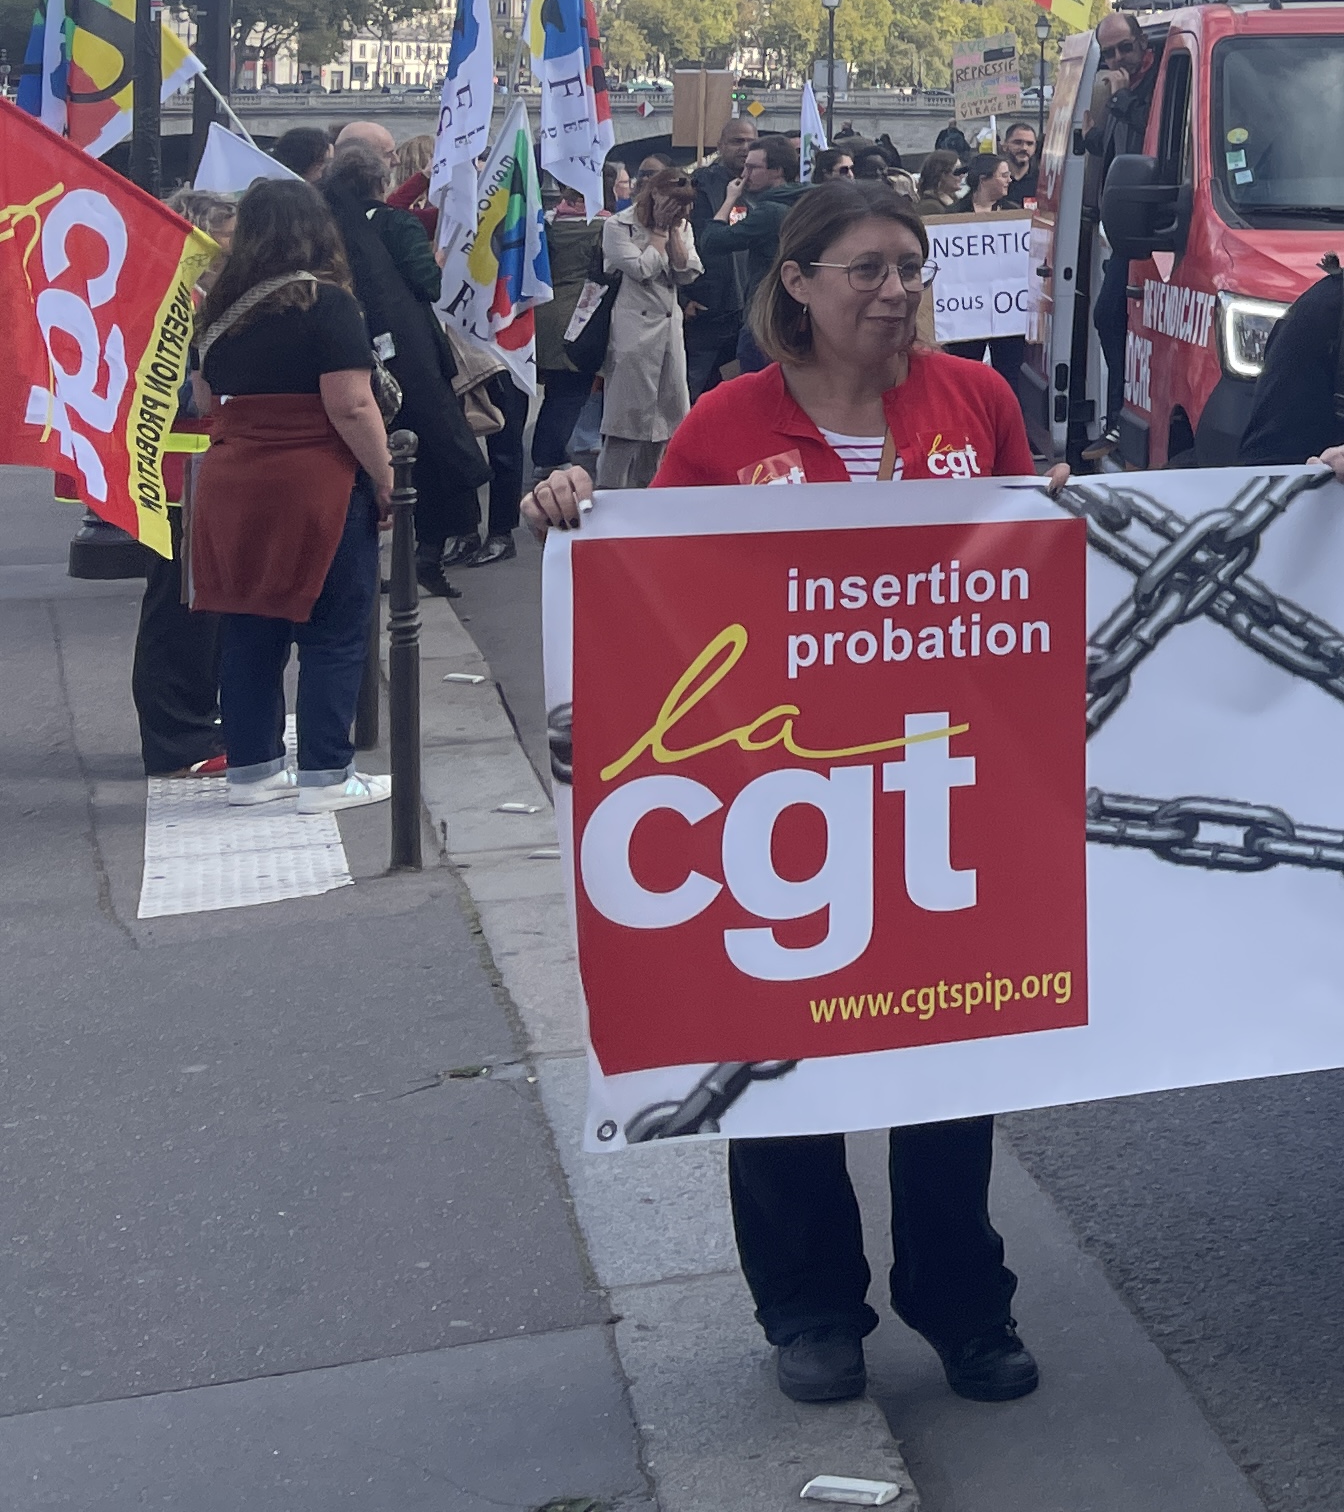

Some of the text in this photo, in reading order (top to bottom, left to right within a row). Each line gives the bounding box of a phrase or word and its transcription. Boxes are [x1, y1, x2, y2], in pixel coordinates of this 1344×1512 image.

[955, 57, 1017, 83] REPRESSIF
[935, 294, 985, 313] sous
[927, 443, 981, 479] cgt
[787, 558, 1031, 613] insertion
[787, 613, 1052, 679] probation
[599, 623, 970, 782] la
[579, 711, 978, 982] cgt
[809, 970, 1073, 1024] www.cgtspip.org
